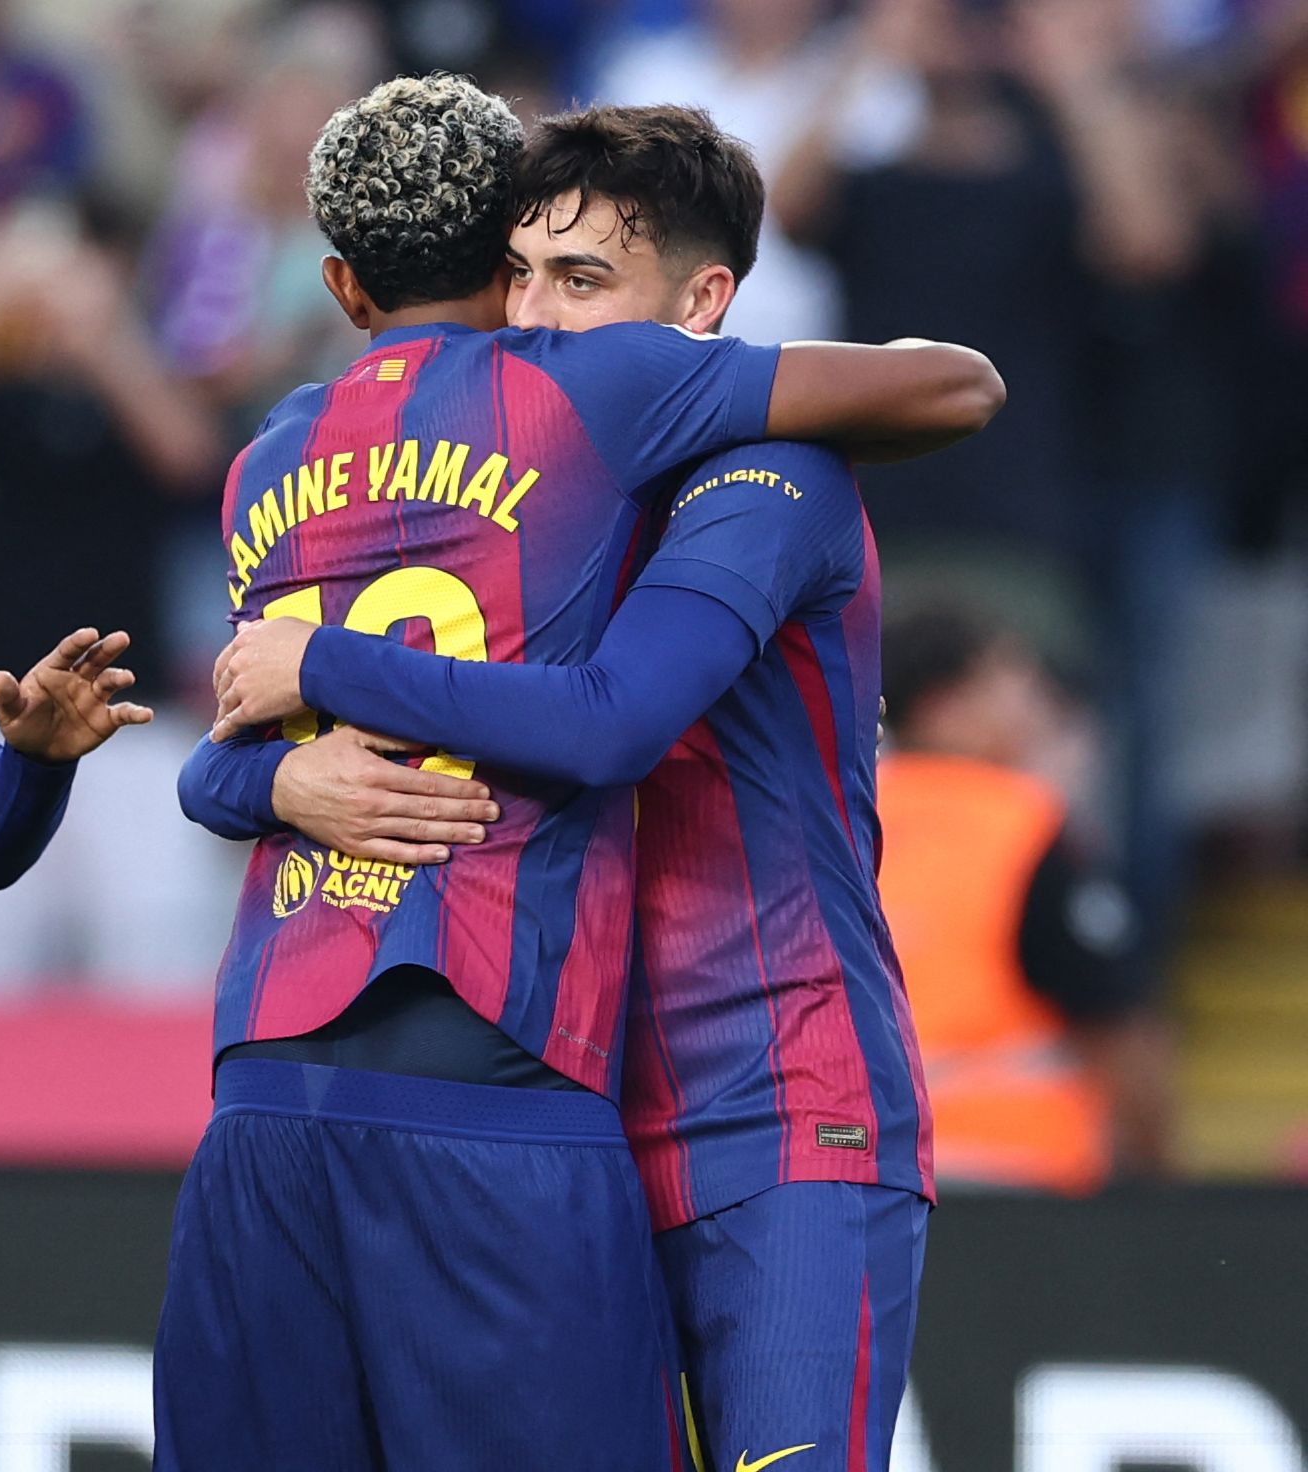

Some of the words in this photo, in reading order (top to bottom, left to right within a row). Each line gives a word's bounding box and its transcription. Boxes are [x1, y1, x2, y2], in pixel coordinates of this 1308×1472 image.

[783, 481, 803, 500] tv
[228, 451, 355, 611] LAMINE
[367, 439, 541, 533] YAMAL
[321, 892, 339, 908] The
